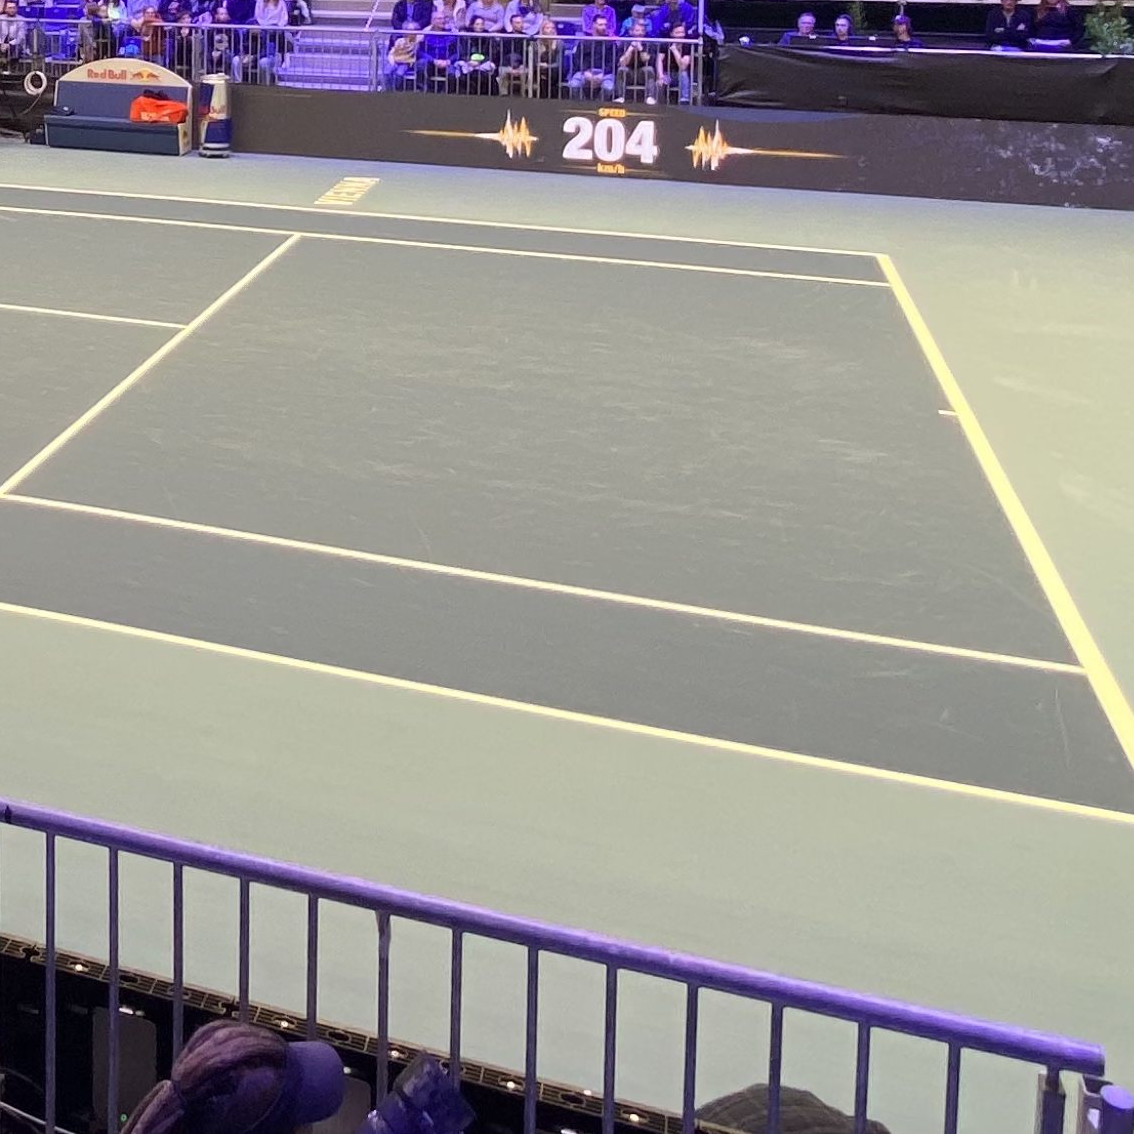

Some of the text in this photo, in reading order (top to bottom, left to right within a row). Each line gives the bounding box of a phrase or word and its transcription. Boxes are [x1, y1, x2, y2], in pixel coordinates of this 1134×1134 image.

[86, 68, 127, 81] Red Bull
[562, 116, 659, 164] 204
